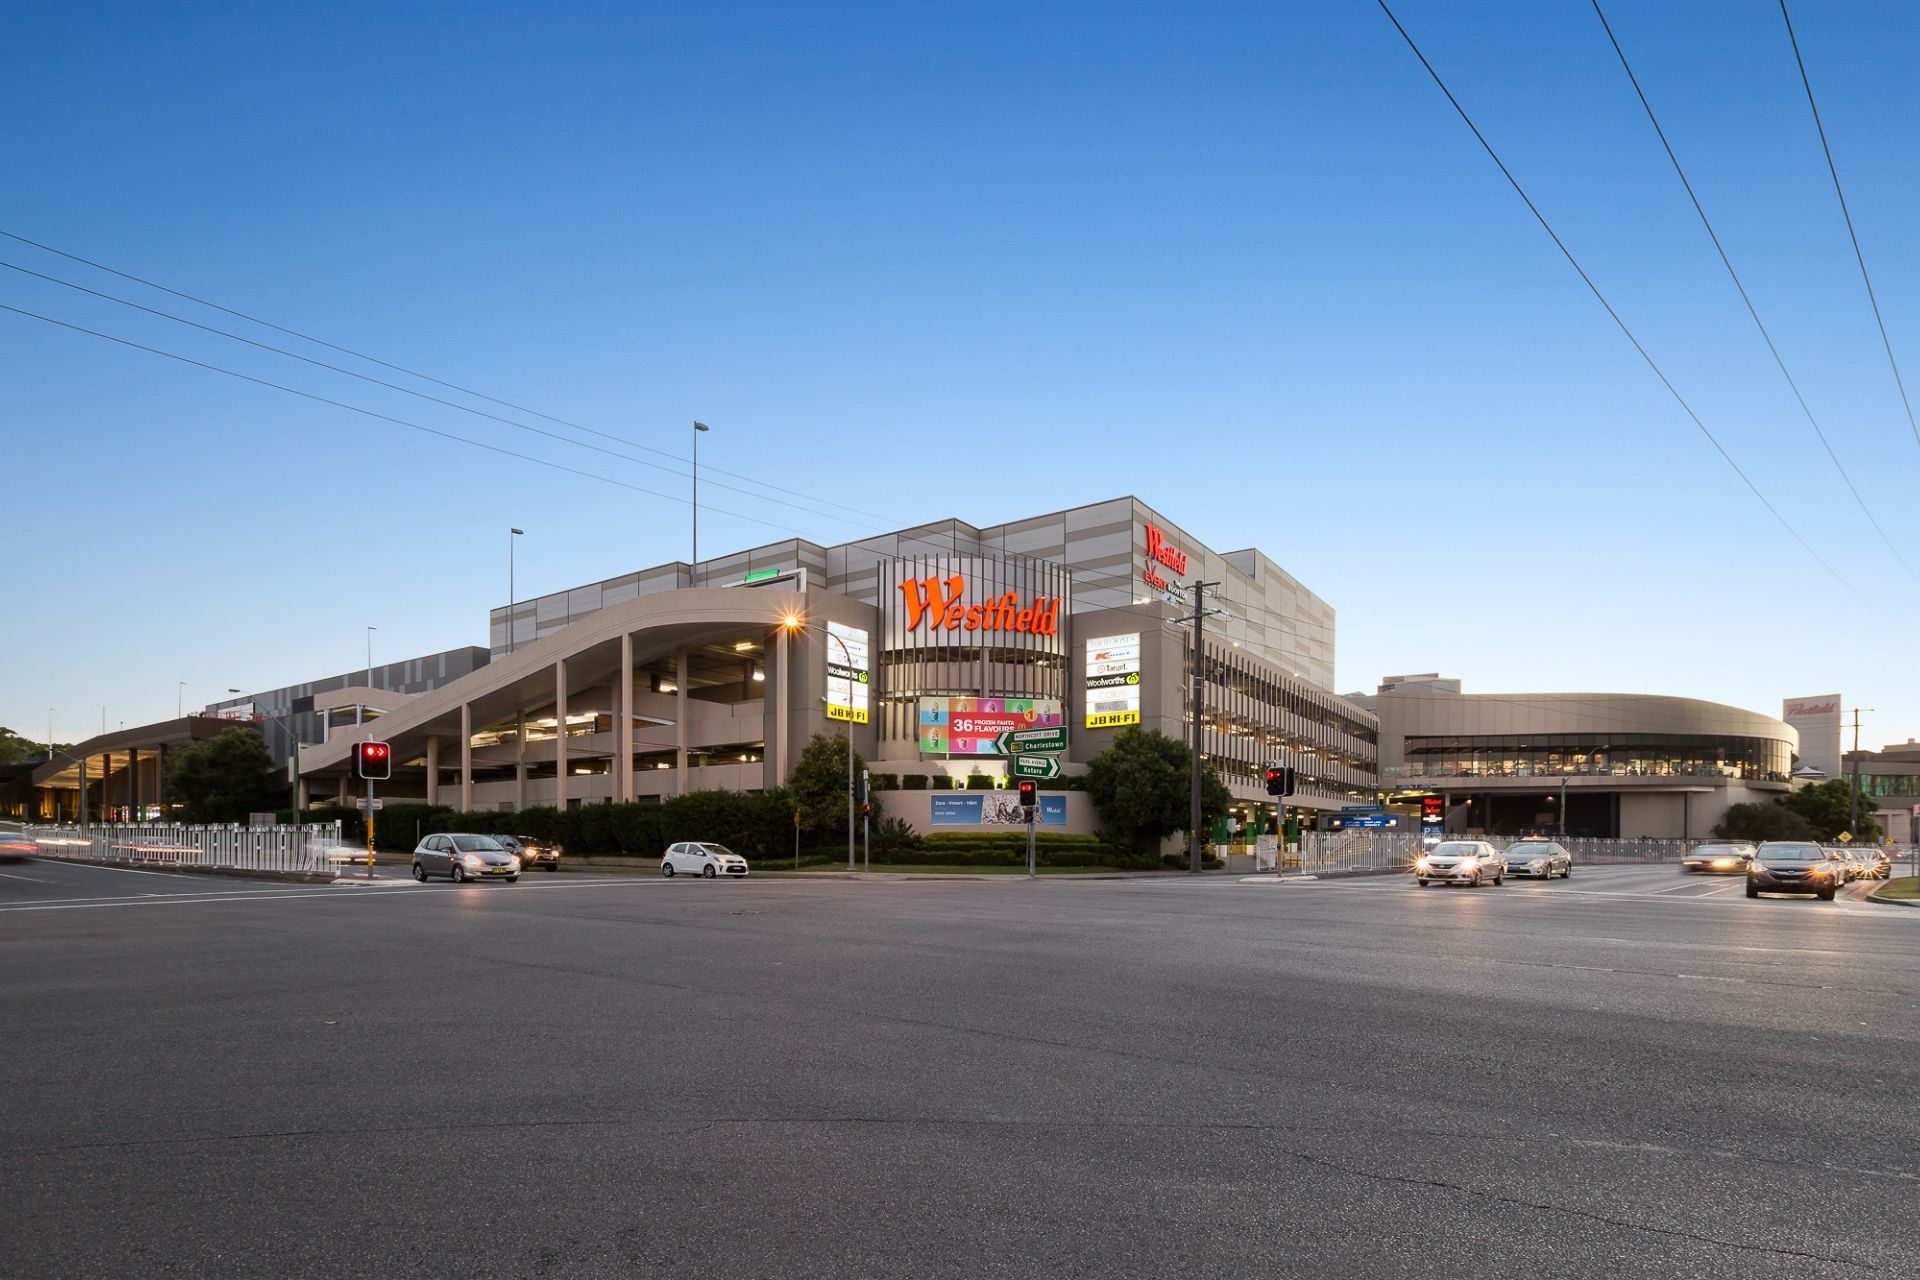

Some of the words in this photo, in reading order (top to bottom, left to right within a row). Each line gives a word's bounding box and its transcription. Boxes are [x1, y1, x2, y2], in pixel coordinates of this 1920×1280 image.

[1144, 523, 1188, 576] Westfield
[1145, 560, 1168, 591] EVENT
[898, 575, 1061, 636] Westfield
[828, 666, 858, 679] Woolworhs
[1086, 676, 1125, 688] Woolworths
[831, 707, 844, 717] JB
[953, 718, 973, 732] 36
[1090, 715, 1107, 725] JB
[1109, 713, 1135, 724] HI-FI
[974, 725, 1015, 733] FLAVOURS
[1025, 742, 1064, 750] Charlestown
